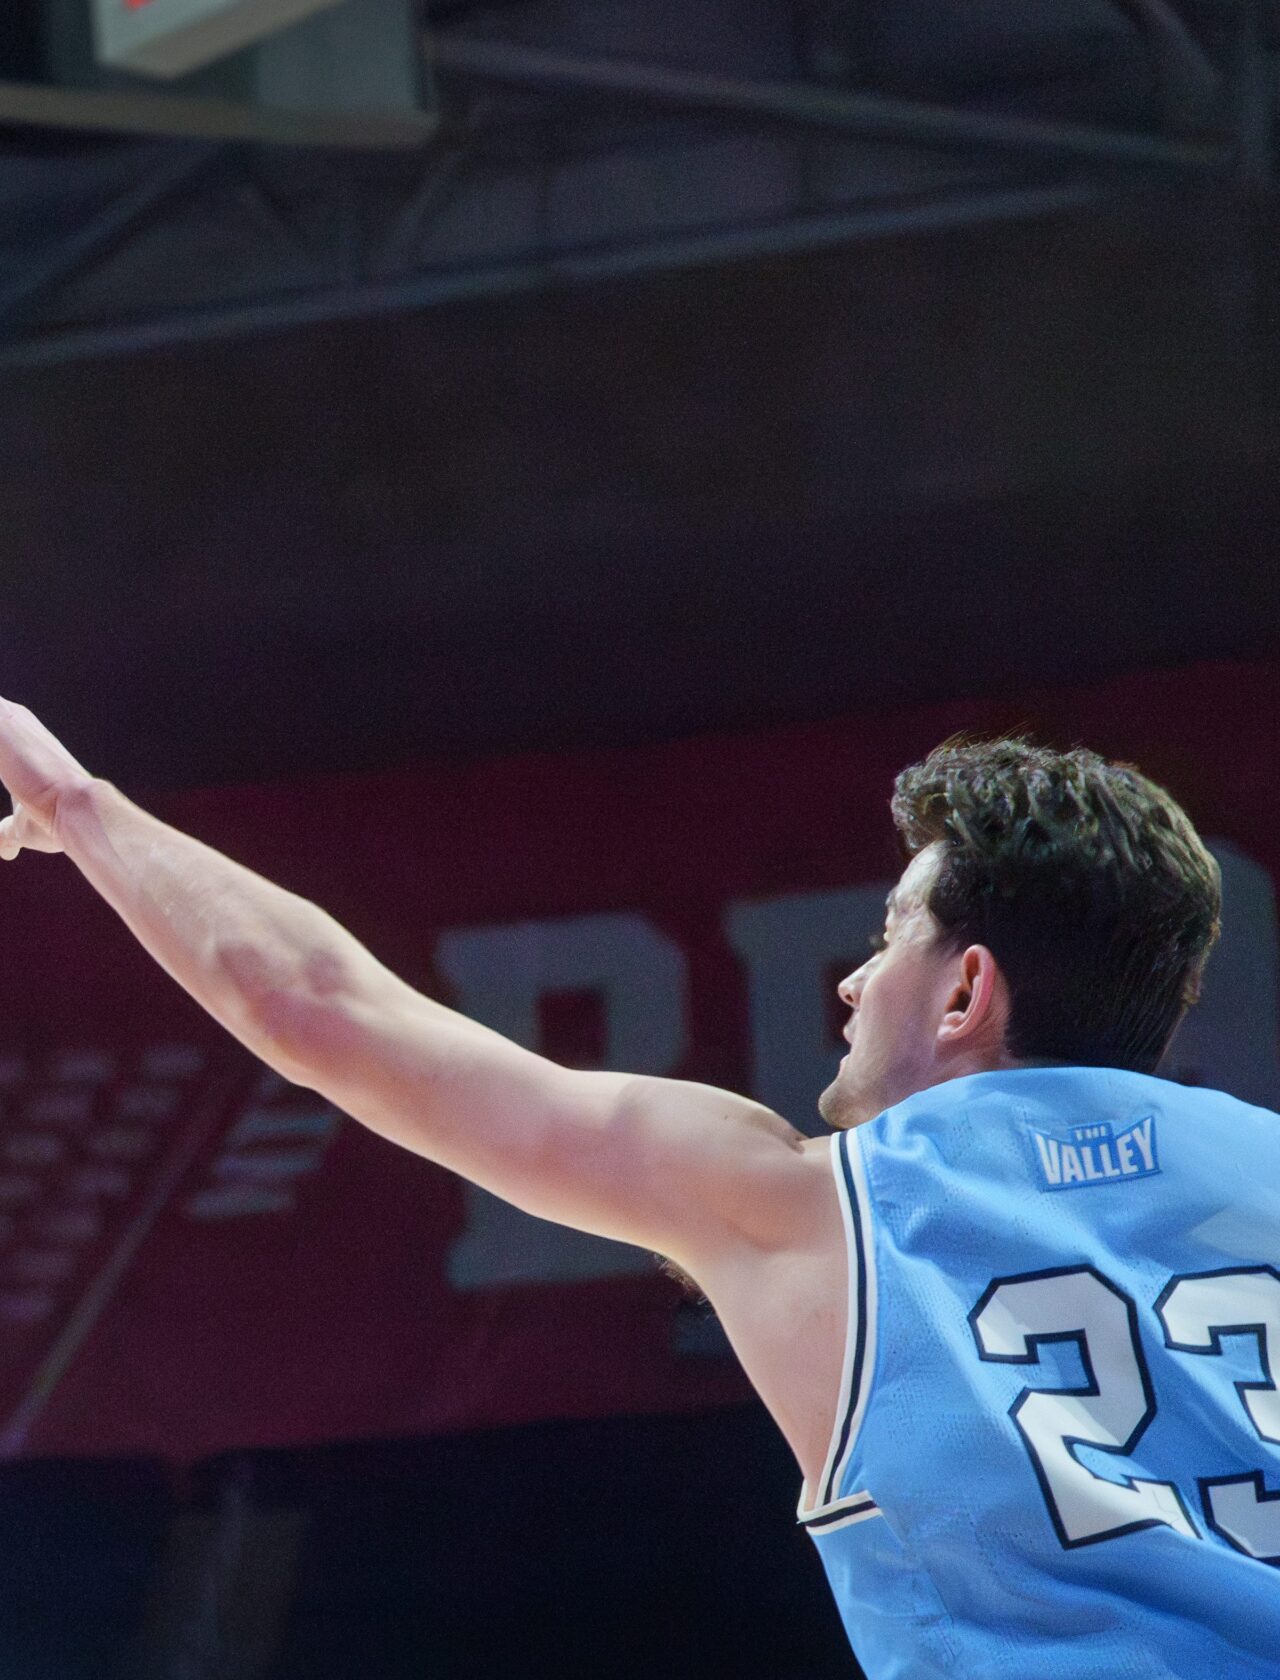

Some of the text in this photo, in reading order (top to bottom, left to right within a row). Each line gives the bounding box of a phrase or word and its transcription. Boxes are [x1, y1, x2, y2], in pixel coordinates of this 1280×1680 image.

[1034, 1117, 1156, 1185] VALLEY
[1074, 1124, 1108, 1142] THE
[968, 1263, 1280, 1564] 23
